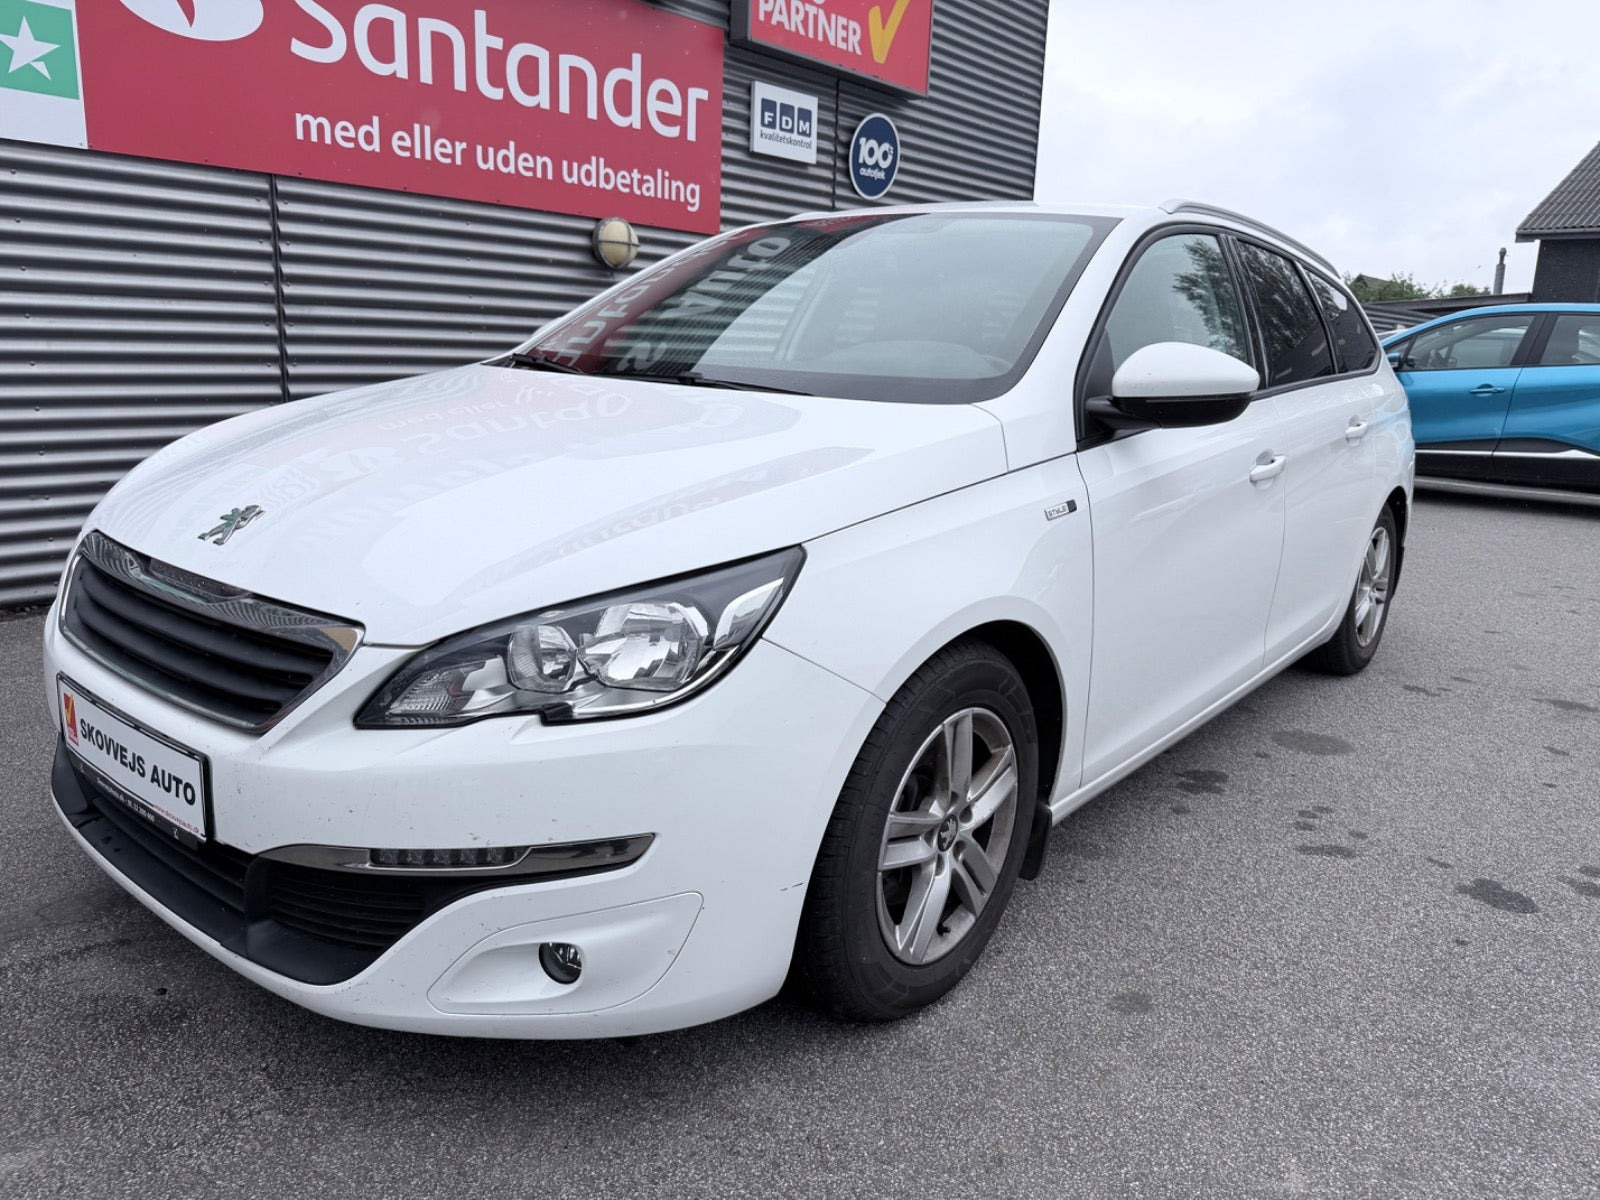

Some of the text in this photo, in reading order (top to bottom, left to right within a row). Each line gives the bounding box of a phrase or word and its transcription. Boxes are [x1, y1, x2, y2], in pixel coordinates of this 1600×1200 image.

[758, 0, 862, 56] PARTNER
[291, 0, 709, 142] Santander
[760, 130, 812, 149] kvalitetskontrol
[764, 111, 810, 134] FDM
[295, 112, 701, 212] med eller uden udbetaling
[80, 718, 146, 778] SKOVVEJS
[150, 765, 196, 806] AUTO
